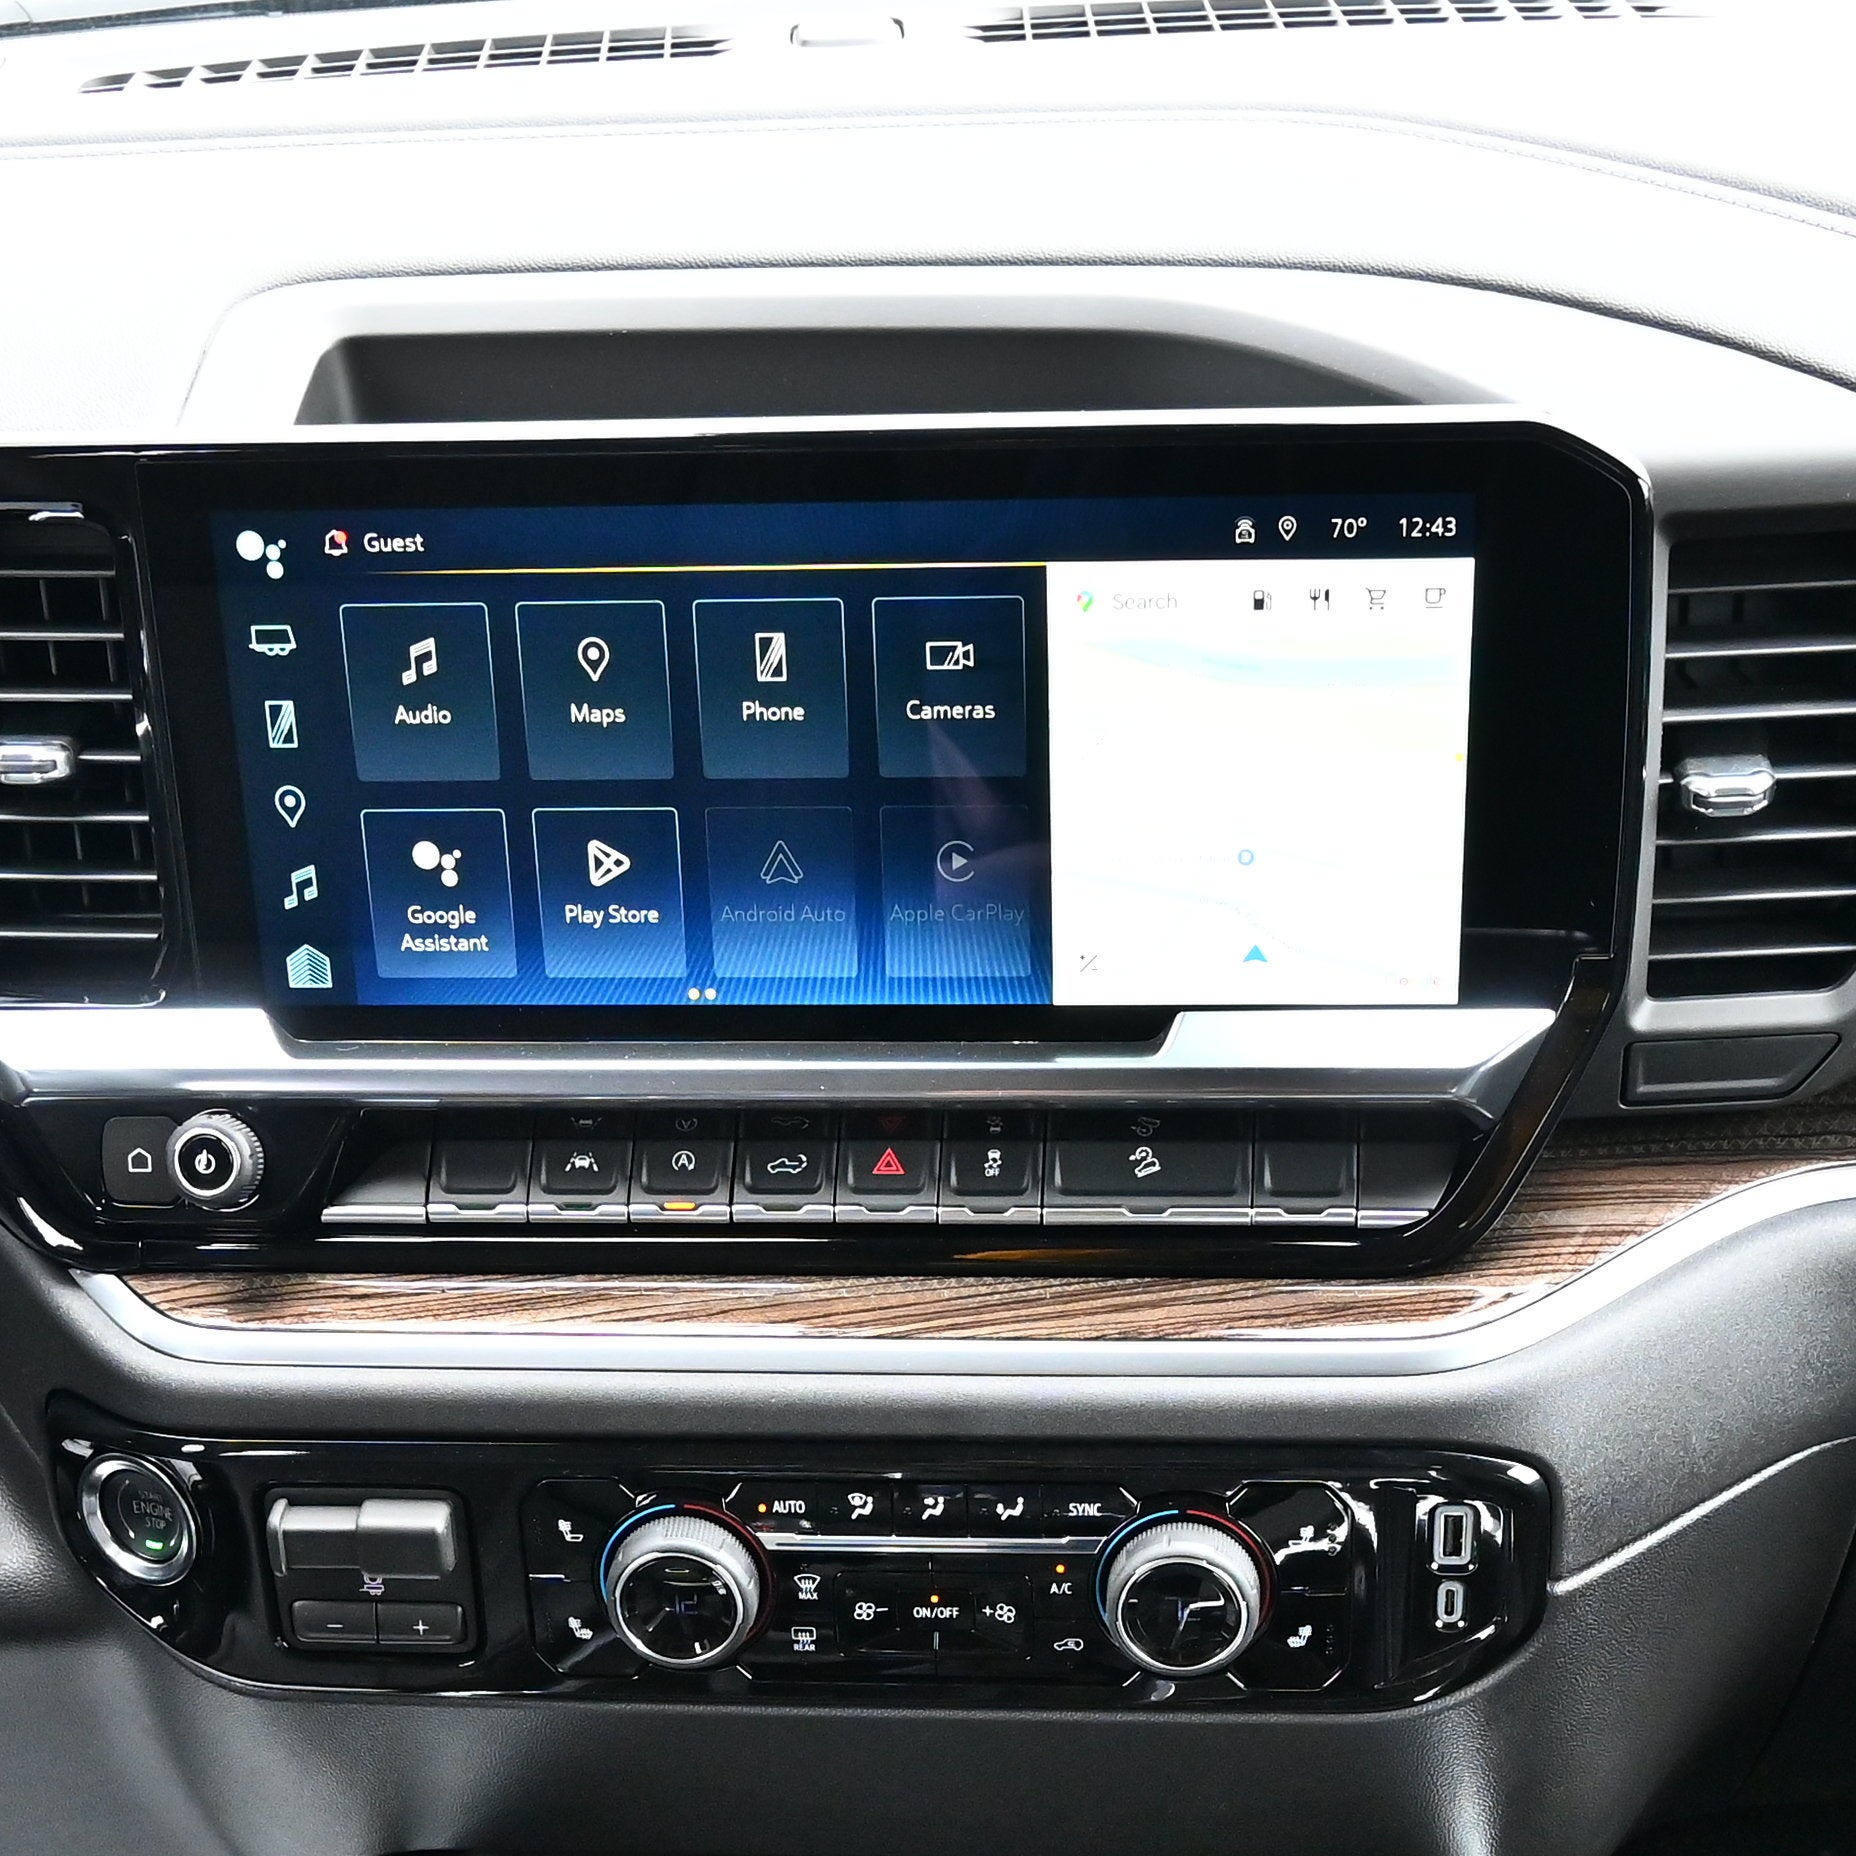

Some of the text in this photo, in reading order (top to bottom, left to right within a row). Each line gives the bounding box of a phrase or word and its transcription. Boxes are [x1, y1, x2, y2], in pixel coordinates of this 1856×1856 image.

[1399, 516, 1457, 537] 12:43
[363, 532, 425, 556] Guest
[394, 703, 452, 726] Audio
[570, 702, 626, 728] Maps
[741, 701, 805, 723] Phone
[905, 700, 996, 721] Cameras
[407, 905, 477, 930] Google
[564, 904, 660, 929] Play Store
[720, 902, 846, 923] Android Auto
[890, 903, 1026, 927] Apple CarPlay
[400, 931, 490, 954] Assistant
[985, 1168, 1000, 1177] OFF
[133, 1500, 173, 1522] ENGINE
[772, 1500, 806, 1513] AUTO
[1068, 1503, 1102, 1517] SYNC
[145, 1517, 167, 1530] STOP
[798, 1591, 819, 1600] MAX
[1050, 1582, 1072, 1594] A/C
[913, 1607, 960, 1619] ON/OFF
[793, 1643, 815, 1651] REAR
